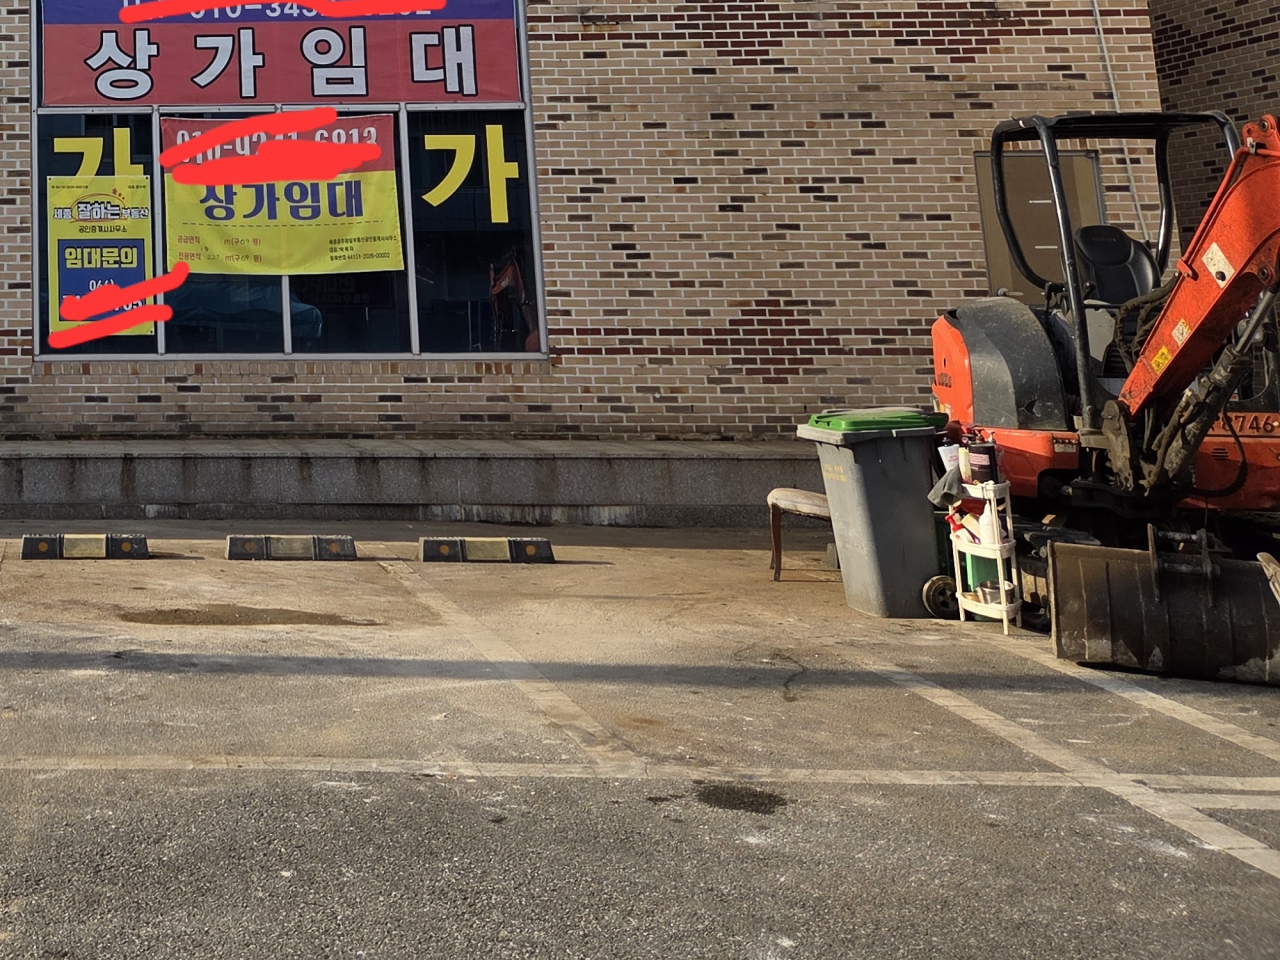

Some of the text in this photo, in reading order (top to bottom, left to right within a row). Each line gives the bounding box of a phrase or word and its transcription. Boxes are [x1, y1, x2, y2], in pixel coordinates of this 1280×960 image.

[421, 124, 520, 224] 가
[77, 201, 121, 220] 잘하는
[199, 180, 364, 221] 상가임대
[64, 246, 139, 269] 임대문의
